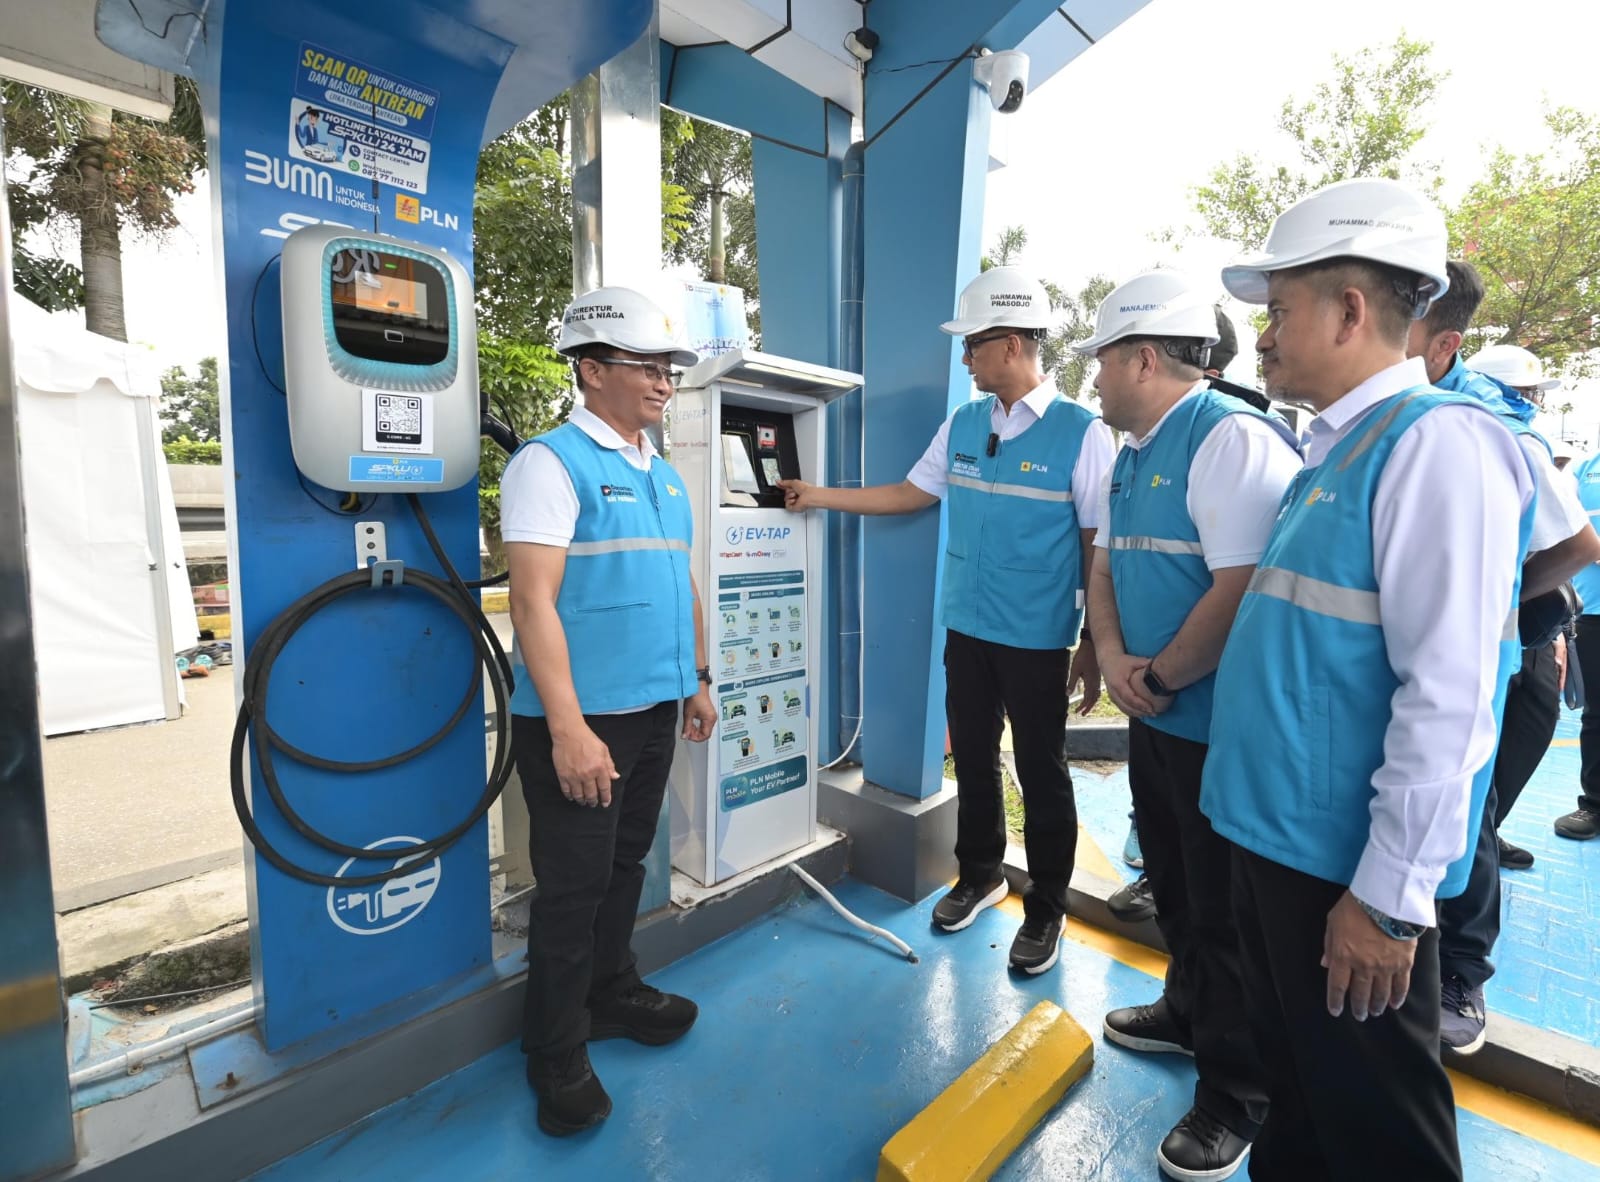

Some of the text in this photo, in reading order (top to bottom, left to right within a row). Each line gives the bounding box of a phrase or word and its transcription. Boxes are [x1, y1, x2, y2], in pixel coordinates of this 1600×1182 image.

[302, 50, 436, 106] SCAN QR UNTUK CHARGING
[308, 71, 426, 120] DAN MASUK ANTREAN
[325, 114, 411, 146] HOTLINE LAYANAN
[363, 154, 375, 162] 123
[398, 145, 424, 162] JAM
[391, 174, 404, 185] 1112
[406, 181, 418, 189] 123
[335, 185, 365, 200] UNTUK
[335, 195, 381, 214] INDONESIA
[420, 206, 458, 231] PLN
[1328, 219, 1374, 227] MUHAMMAD
[573, 306, 613, 315] DIREKTUR
[588, 312, 594, 320] &
[1031, 463, 1048, 473] PLN
[1159, 478, 1171, 486] PLN
[1315, 492, 1336, 503] PLN
[746, 528, 790, 540] EV-TAP
[750, 770, 784, 786] PLN Mobile
[726, 787, 737, 795] PLN
[751, 785, 766, 795] Your
[766, 782, 776, 790] EV
